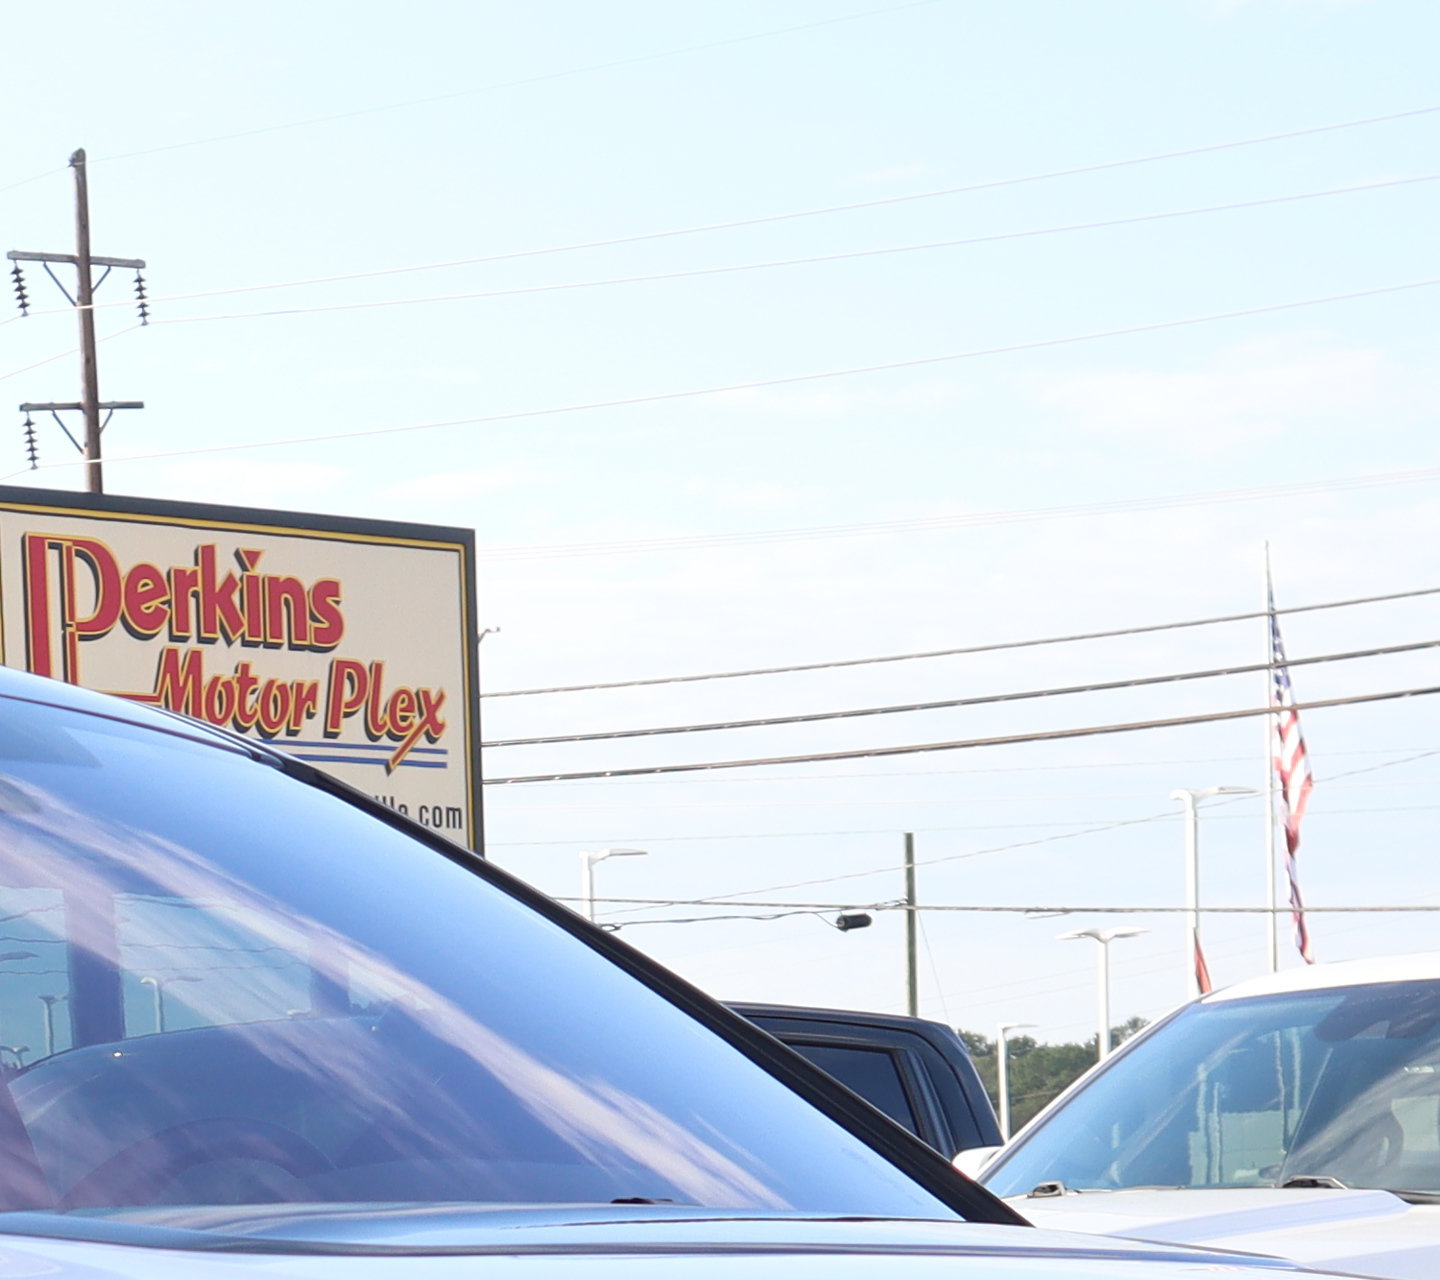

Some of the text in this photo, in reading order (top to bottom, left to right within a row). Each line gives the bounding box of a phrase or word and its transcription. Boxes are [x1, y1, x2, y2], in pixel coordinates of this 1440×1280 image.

[21, 531, 346, 687] Perkins
[157, 646, 448, 774] Motor Plex
